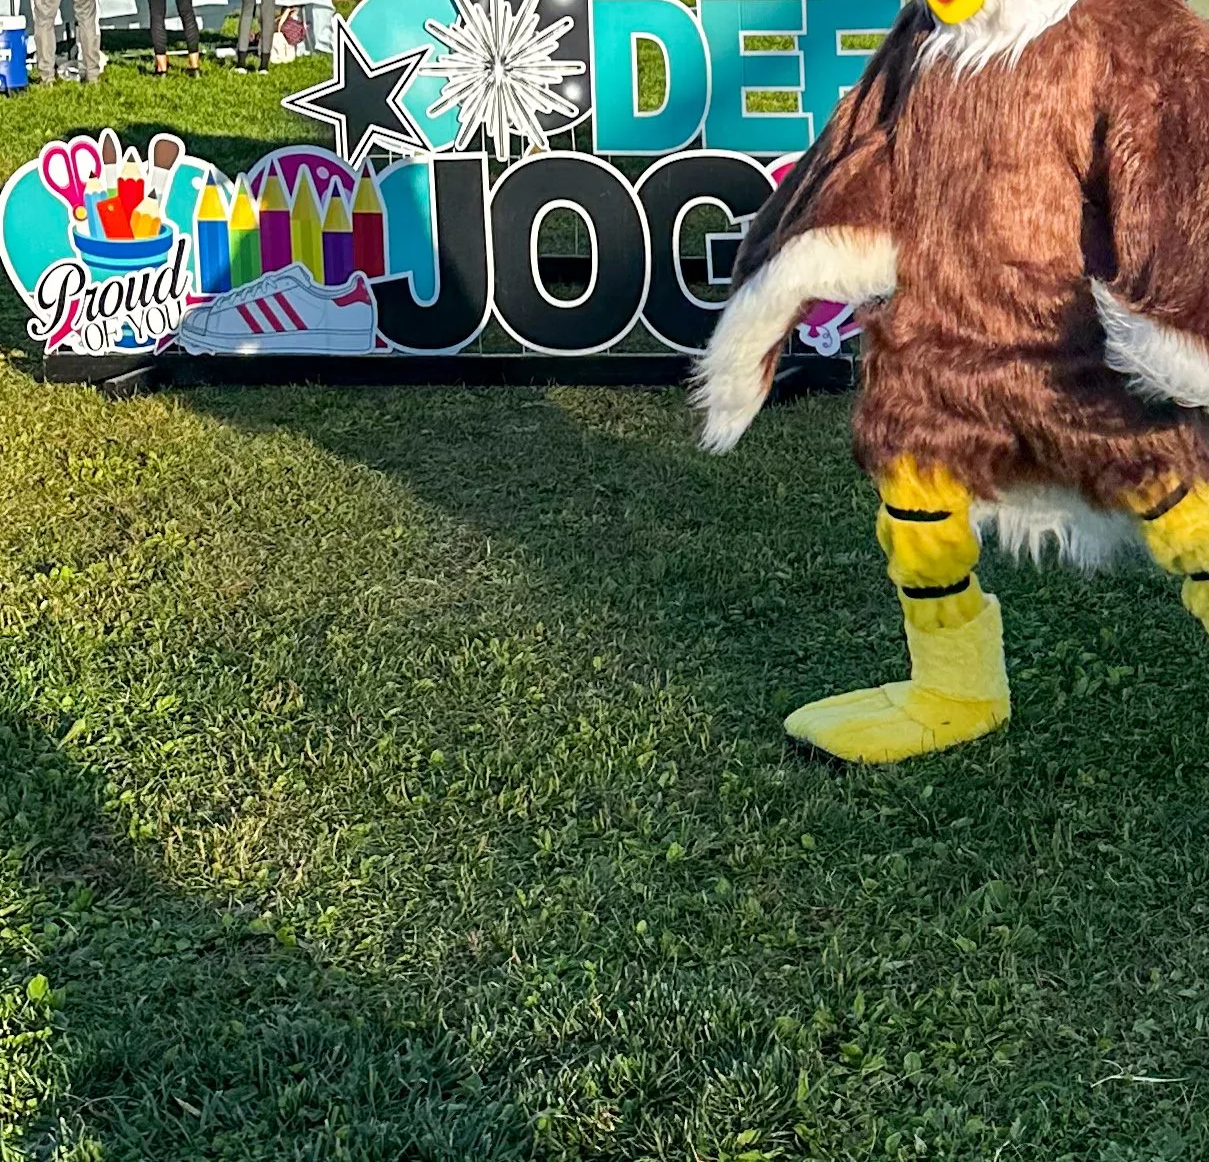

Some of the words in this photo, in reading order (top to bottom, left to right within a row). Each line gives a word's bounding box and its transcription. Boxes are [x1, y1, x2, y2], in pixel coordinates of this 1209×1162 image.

[32, 239, 188, 334] Proud
[84, 317, 119, 351] OF
[126, 300, 182, 339] YOU
